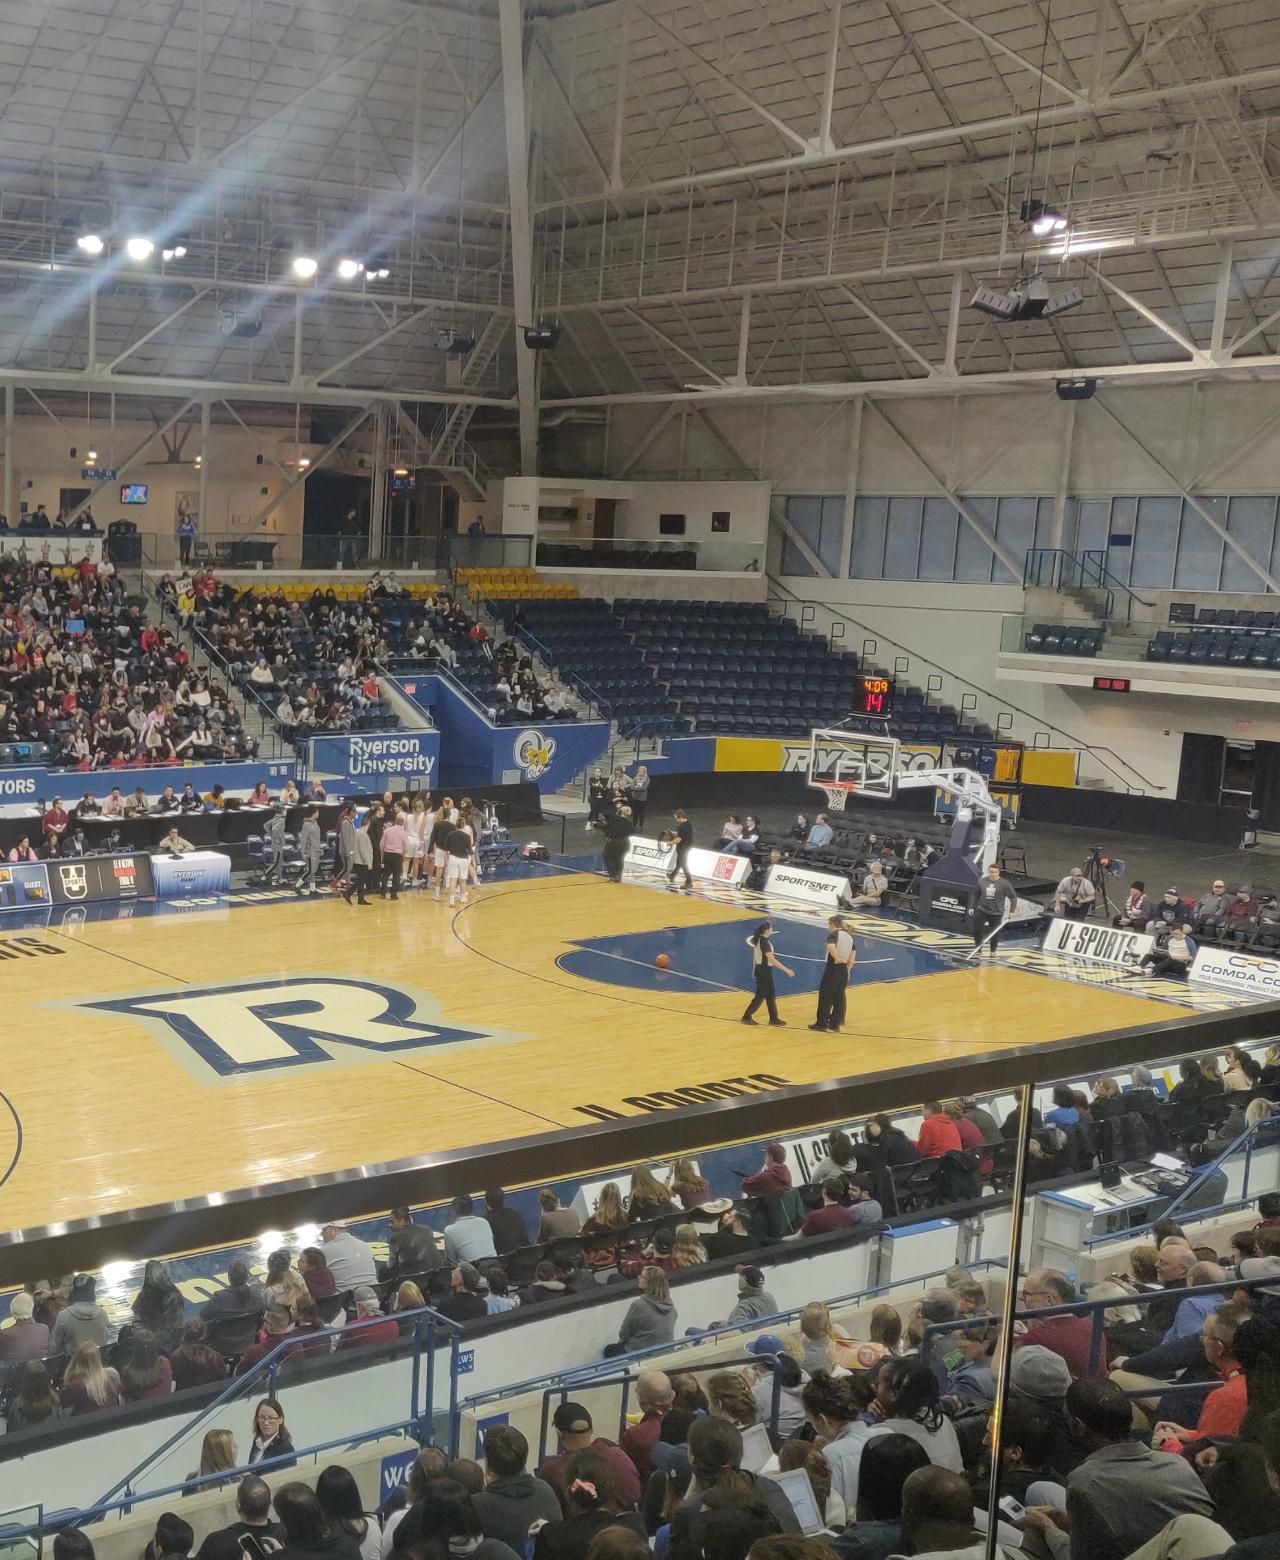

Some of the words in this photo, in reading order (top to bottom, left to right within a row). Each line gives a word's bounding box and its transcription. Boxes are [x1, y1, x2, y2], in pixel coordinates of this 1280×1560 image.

[864, 680, 888, 693] 4:09
[865, 693, 883, 713] 14
[349, 737, 420, 760] Ryerson
[349, 752, 436, 775] University
[784, 745, 953, 775] RYERSO
[24, 880, 41, 889] GUEST
[775, 873, 838, 894] SPORTSNET
[1058, 922, 1072, 950] U
[1075, 925, 1140, 964] SPORTS
